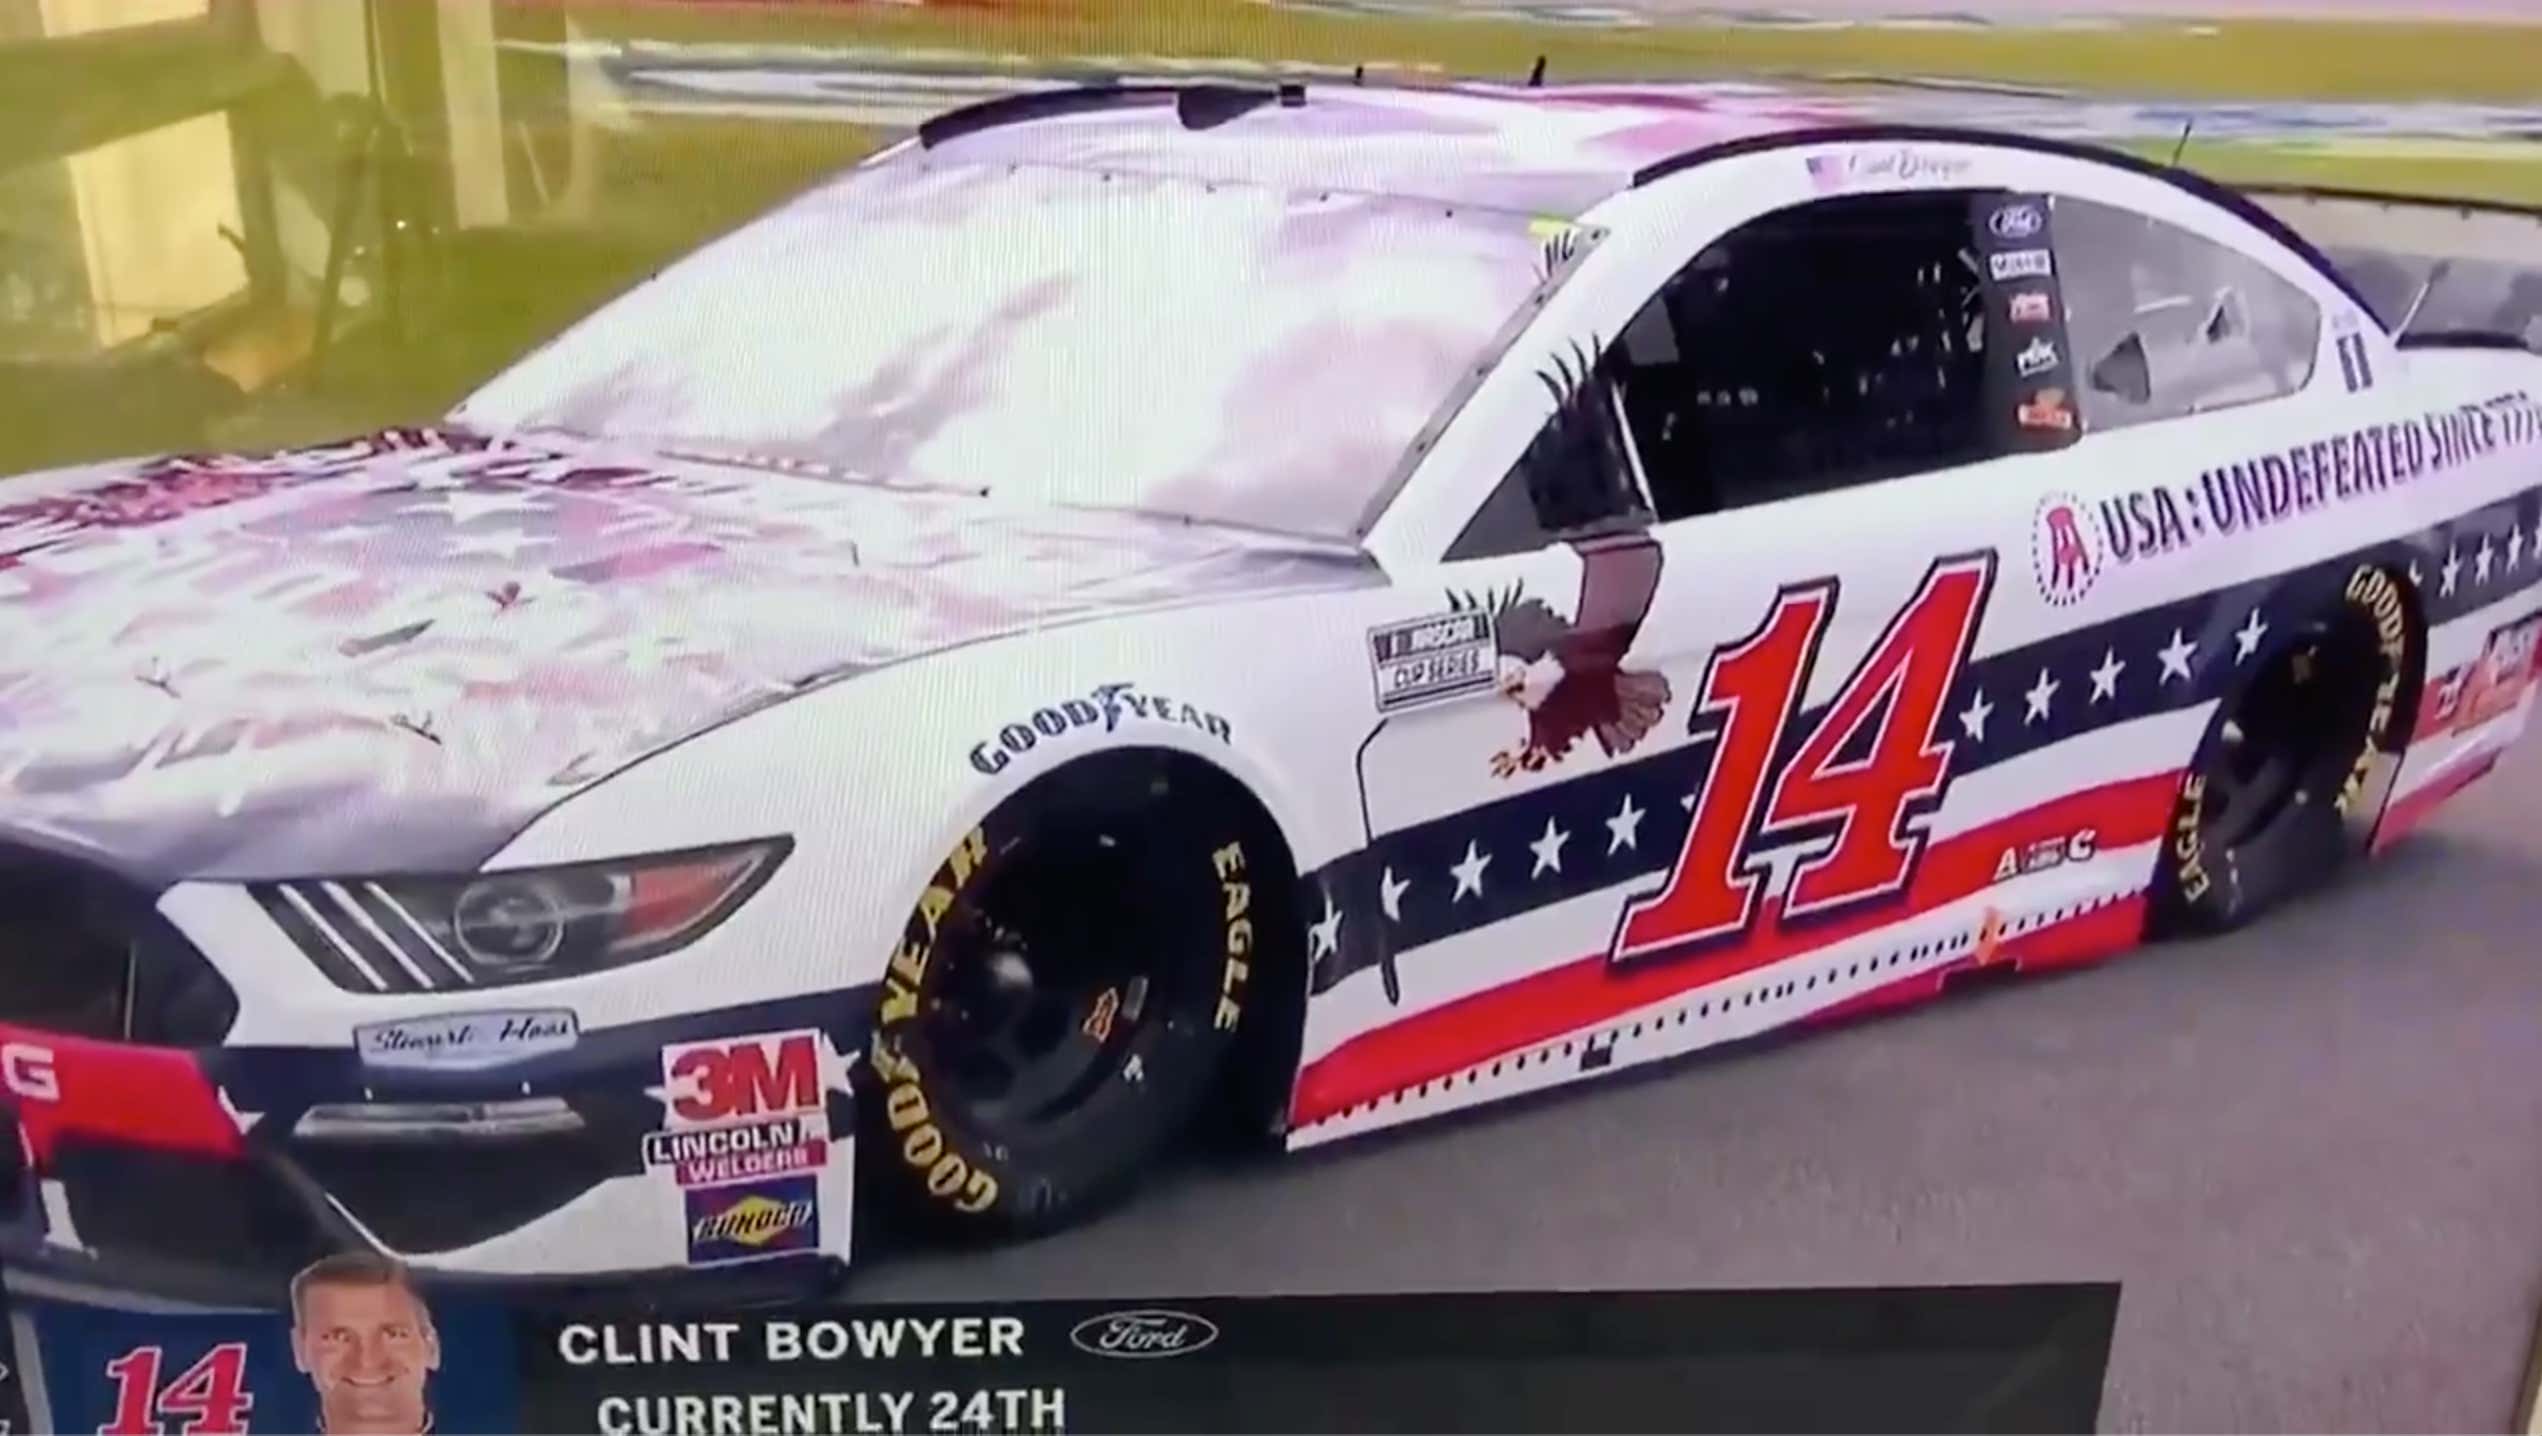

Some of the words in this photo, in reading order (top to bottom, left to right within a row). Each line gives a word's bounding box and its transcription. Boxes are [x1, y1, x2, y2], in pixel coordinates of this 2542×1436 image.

[2202, 418, 2424, 538] UNDEFEATED
[2424, 404, 2496, 469] SINCE
[969, 682, 1231, 775] GOODYEAR
[1612, 548, 1998, 972] 14
[2175, 773, 2210, 903] EAGLE
[1212, 841, 1254, 1034] EAGLE
[871, 826, 998, 1213] GOODYEAR
[671, 1034, 820, 1121] 3M
[653, 1121, 796, 1163] LINCOLN
[693, 1200, 813, 1241] SUNOCO
[558, 1323, 741, 1365] CLINT
[765, 1317, 1026, 1362] BOWYER
[100, 1342, 254, 1436] 14
[598, 1391, 914, 1436] CURRENTLY
[929, 1388, 1066, 1432] 24TH
